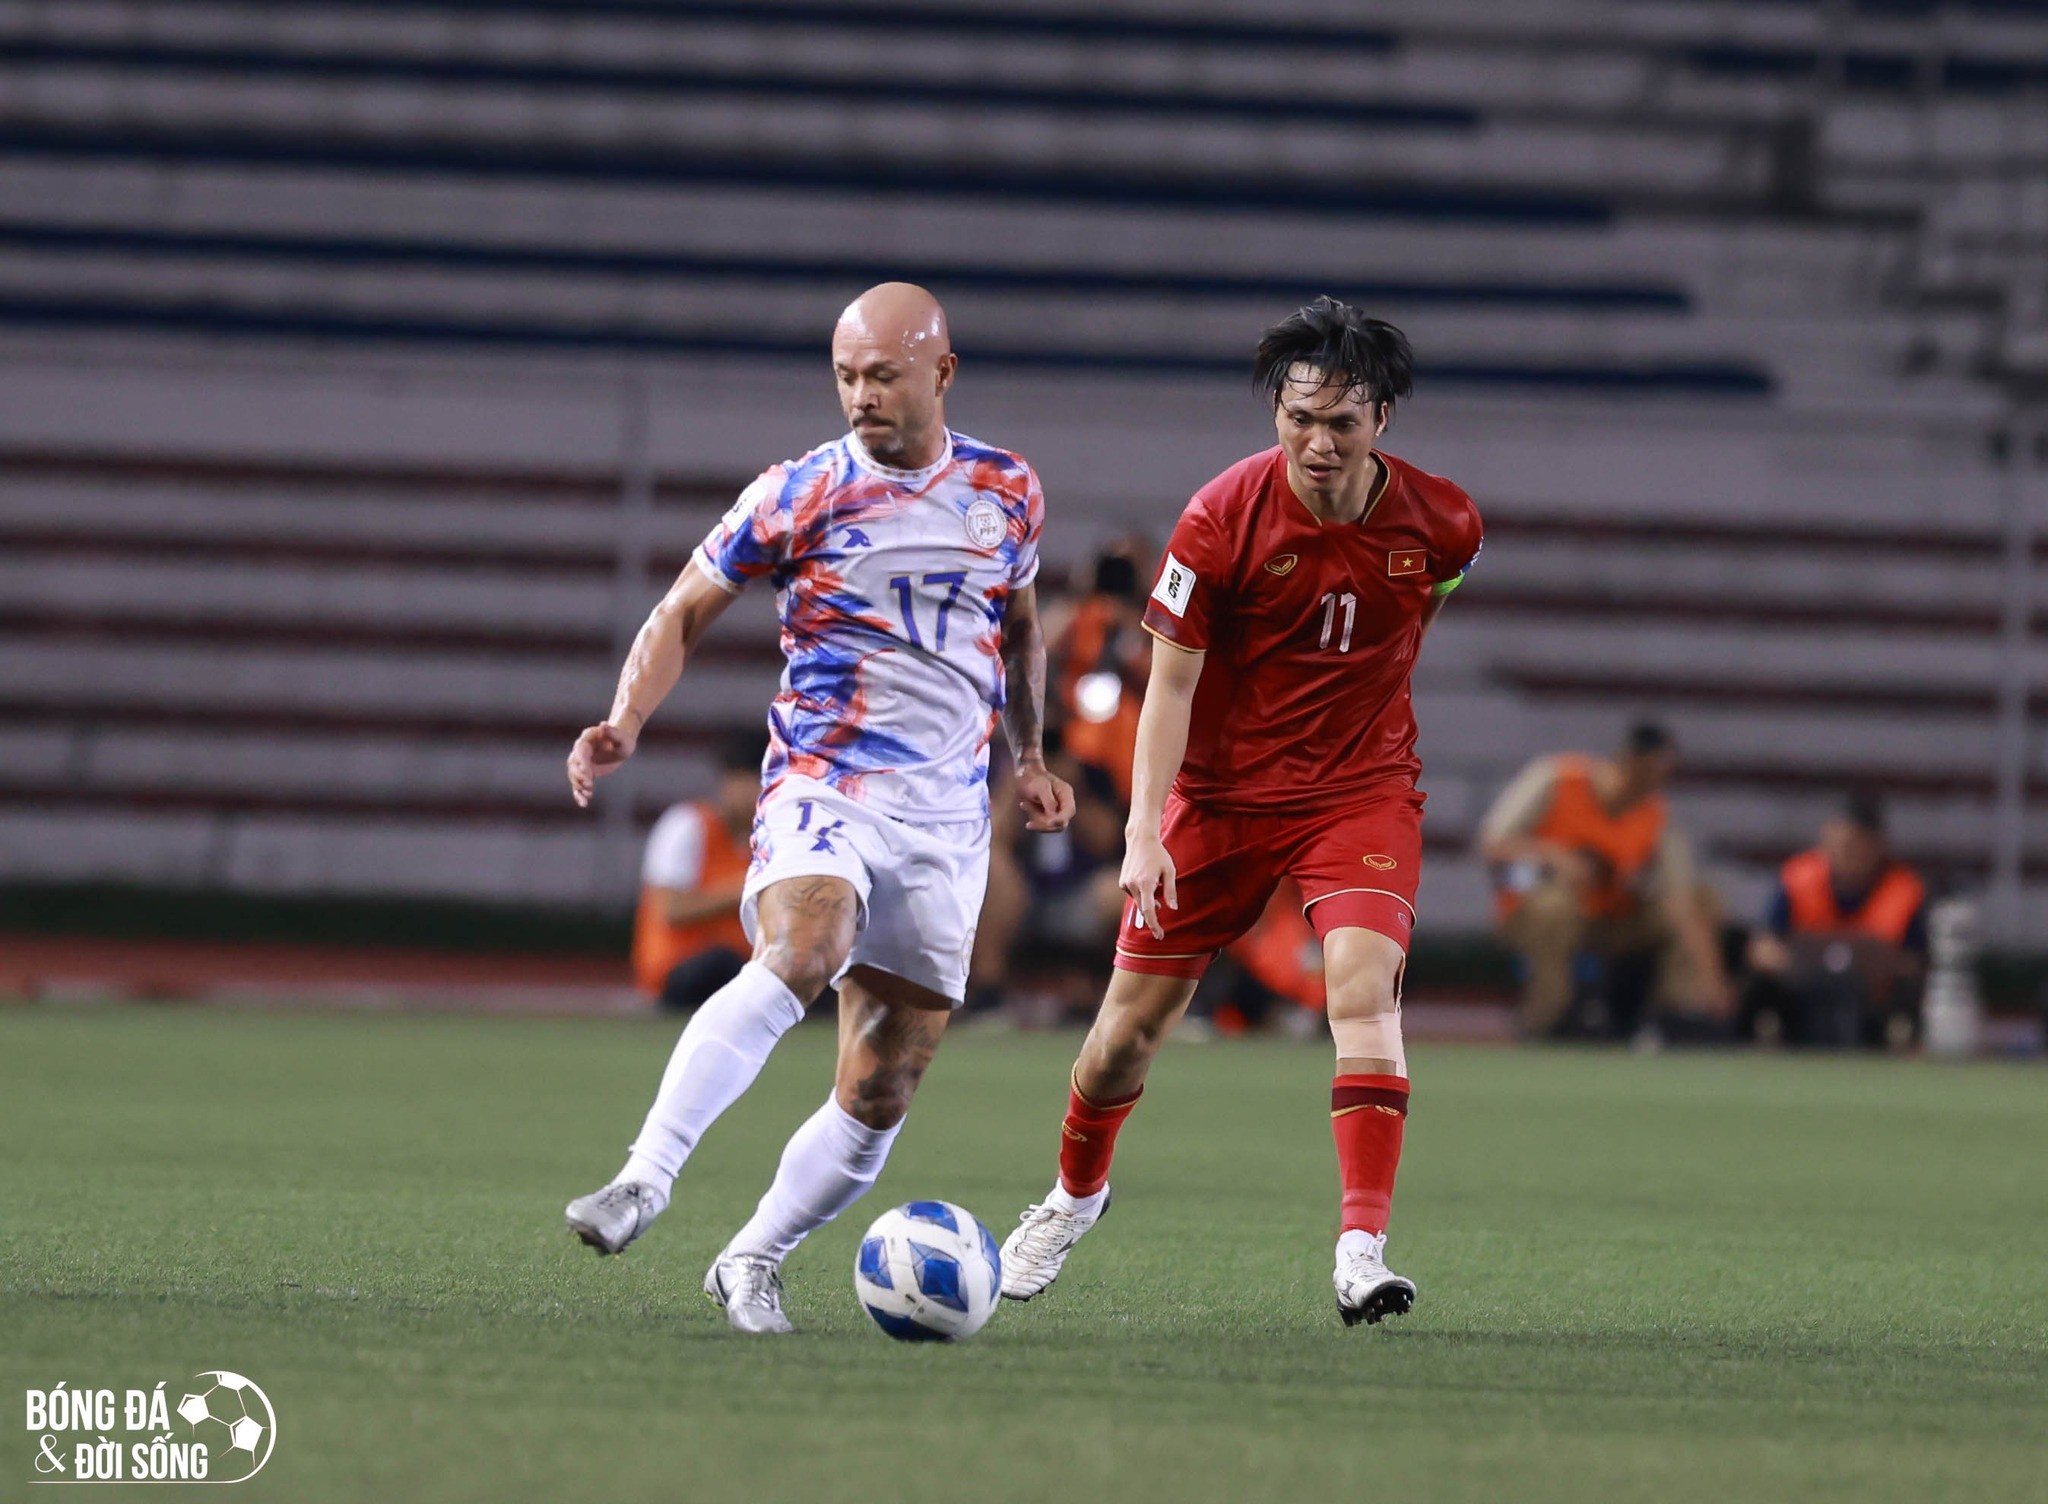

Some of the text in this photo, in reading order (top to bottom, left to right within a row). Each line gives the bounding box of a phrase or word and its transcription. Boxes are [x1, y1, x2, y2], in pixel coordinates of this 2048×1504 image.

[980, 525, 998, 536] PFF
[888, 570, 968, 652] 17
[1320, 592, 1357, 653] 11
